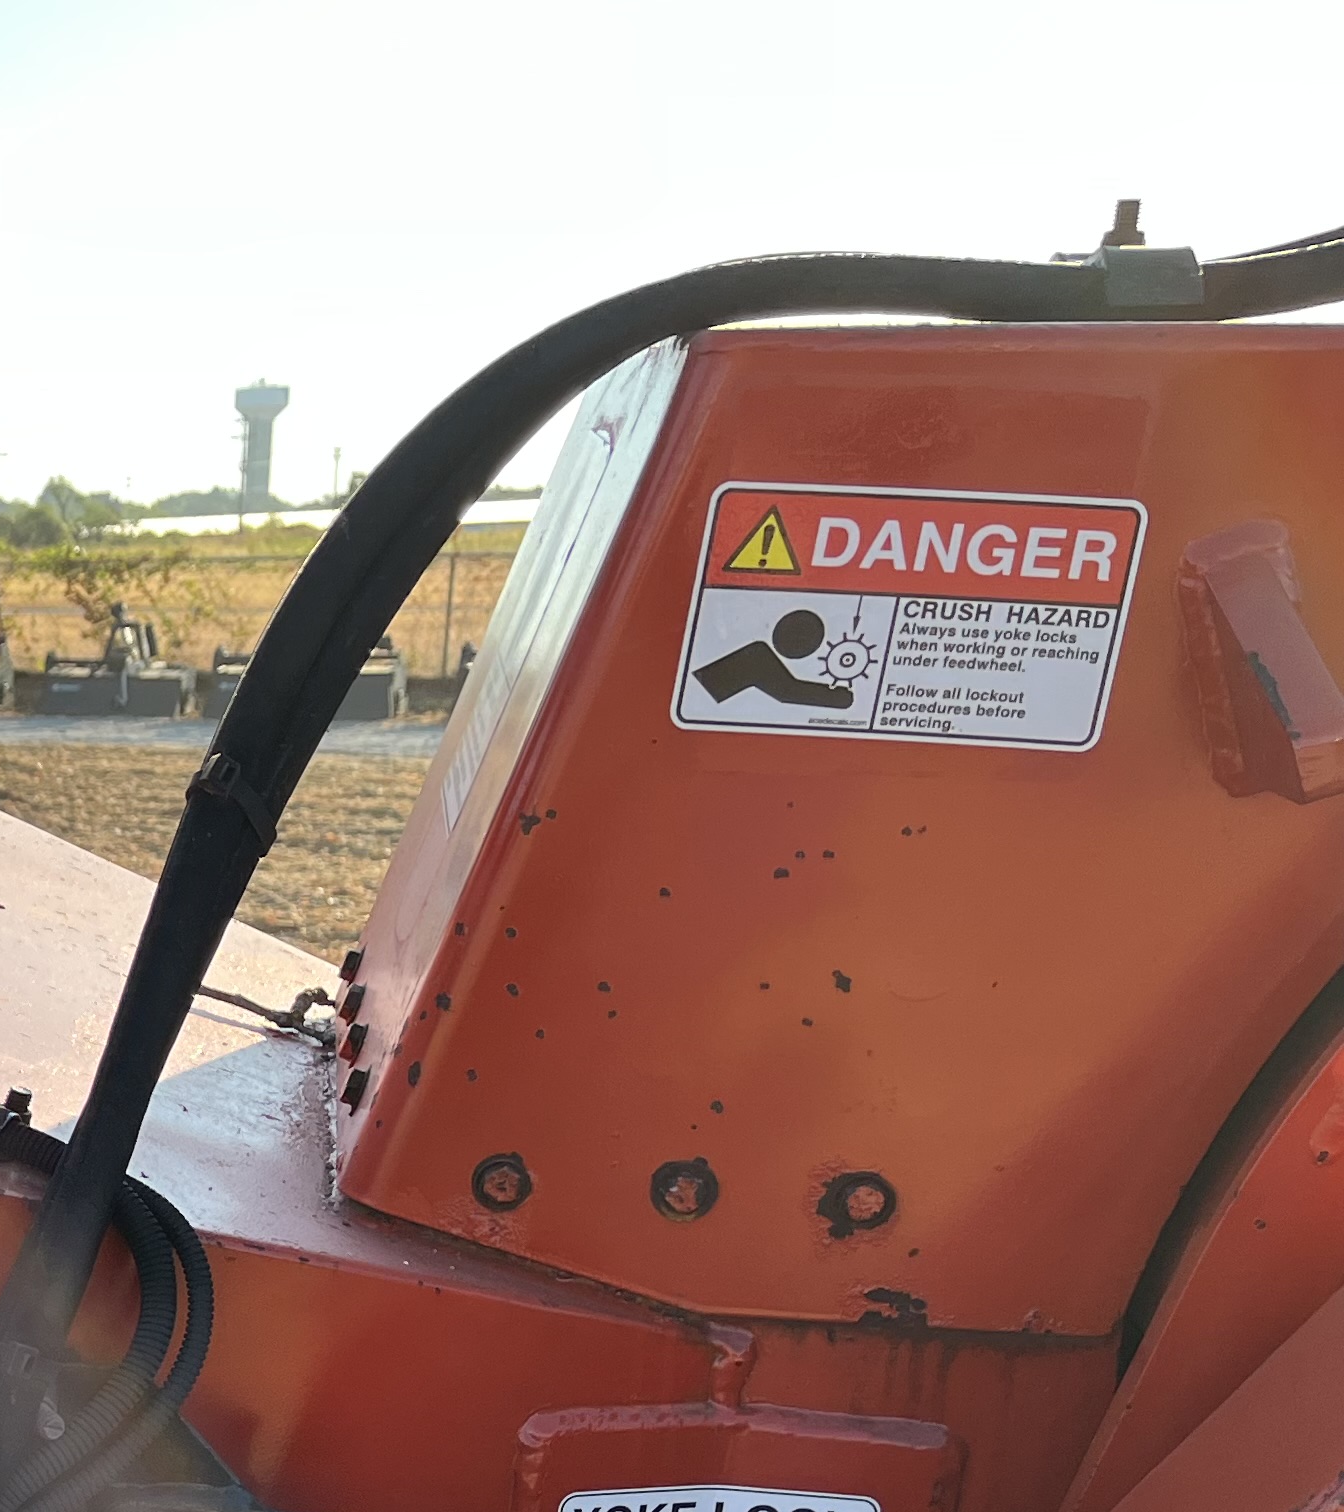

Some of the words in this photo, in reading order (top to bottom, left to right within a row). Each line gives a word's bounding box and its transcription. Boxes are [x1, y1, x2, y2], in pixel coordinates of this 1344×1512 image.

[811, 516, 1117, 582] DANGER
[903, 600, 993, 623] CRUSH
[1006, 605, 1110, 629] HAZARD
[899, 622, 957, 640] Always
[961, 628, 990, 639] use
[993, 627, 1031, 643] yoke
[1035, 629, 1077, 644] locks
[896, 639, 938, 656] when
[943, 642, 1006, 660] working
[1010, 646, 1028, 657] or
[1031, 646, 1100, 665] reaching
[892, 654, 939, 668] under
[942, 656, 1026, 673] feedwheel.
[885, 683, 939, 699] Follow
[942, 687, 962, 700] all
[965, 687, 1025, 704] lockout
[881, 701, 971, 719] procedures
[975, 704, 1026, 719] before
[879, 716, 955, 733] servicing.
